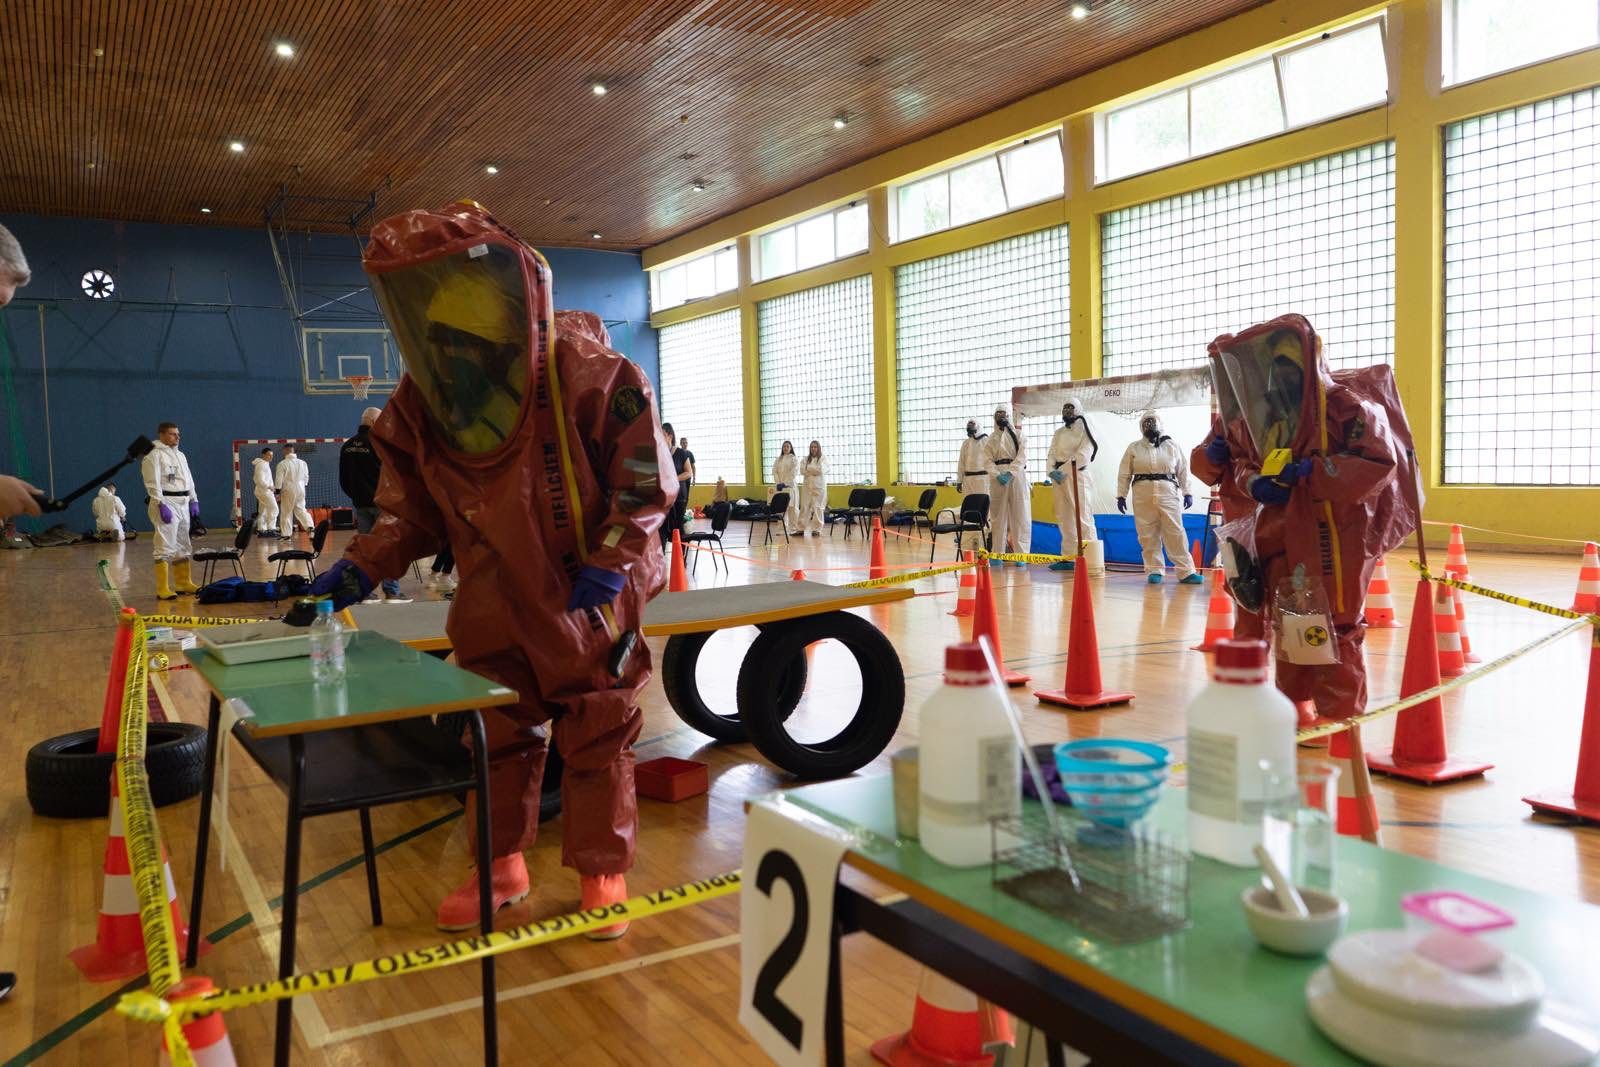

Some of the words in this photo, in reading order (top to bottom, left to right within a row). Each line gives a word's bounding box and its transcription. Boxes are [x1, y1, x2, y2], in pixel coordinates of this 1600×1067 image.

[1104, 389, 1121, 397] DEKO
[543, 442, 569, 530] TRELLCHEM
[752, 848, 811, 1055] 2
